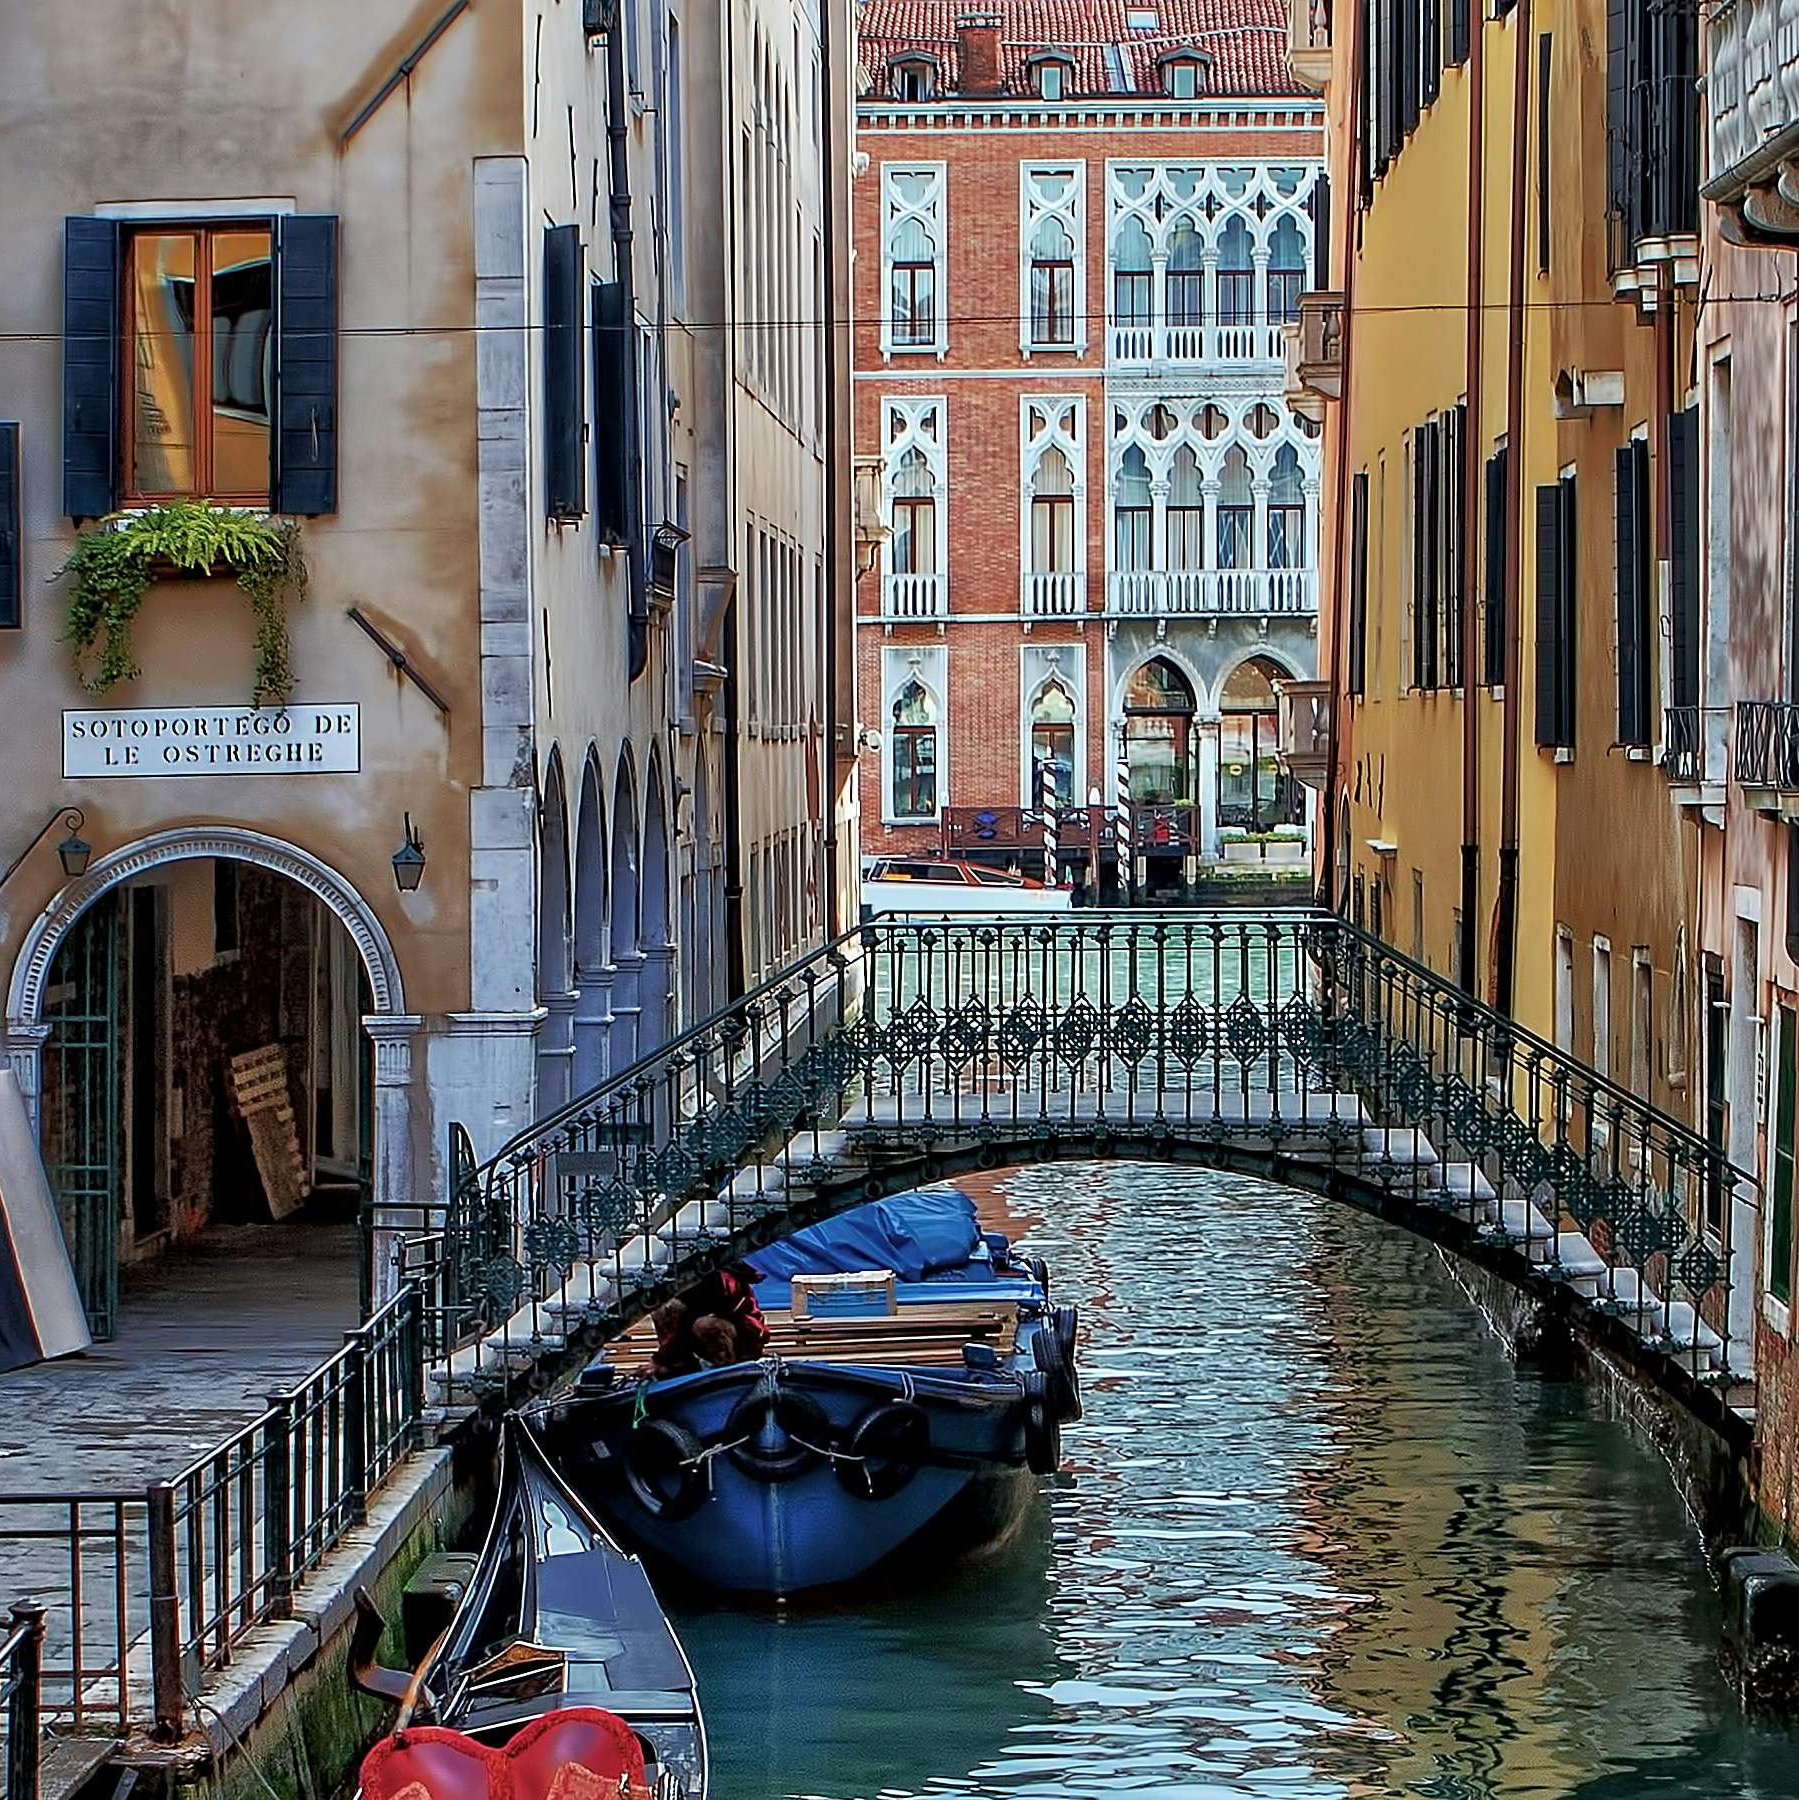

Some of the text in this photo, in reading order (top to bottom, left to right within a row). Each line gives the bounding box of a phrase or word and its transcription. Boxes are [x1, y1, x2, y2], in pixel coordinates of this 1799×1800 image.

[72, 715, 351, 738] SOTOPORTEGO DE
[105, 743, 323, 765] LE OSTREGHE
